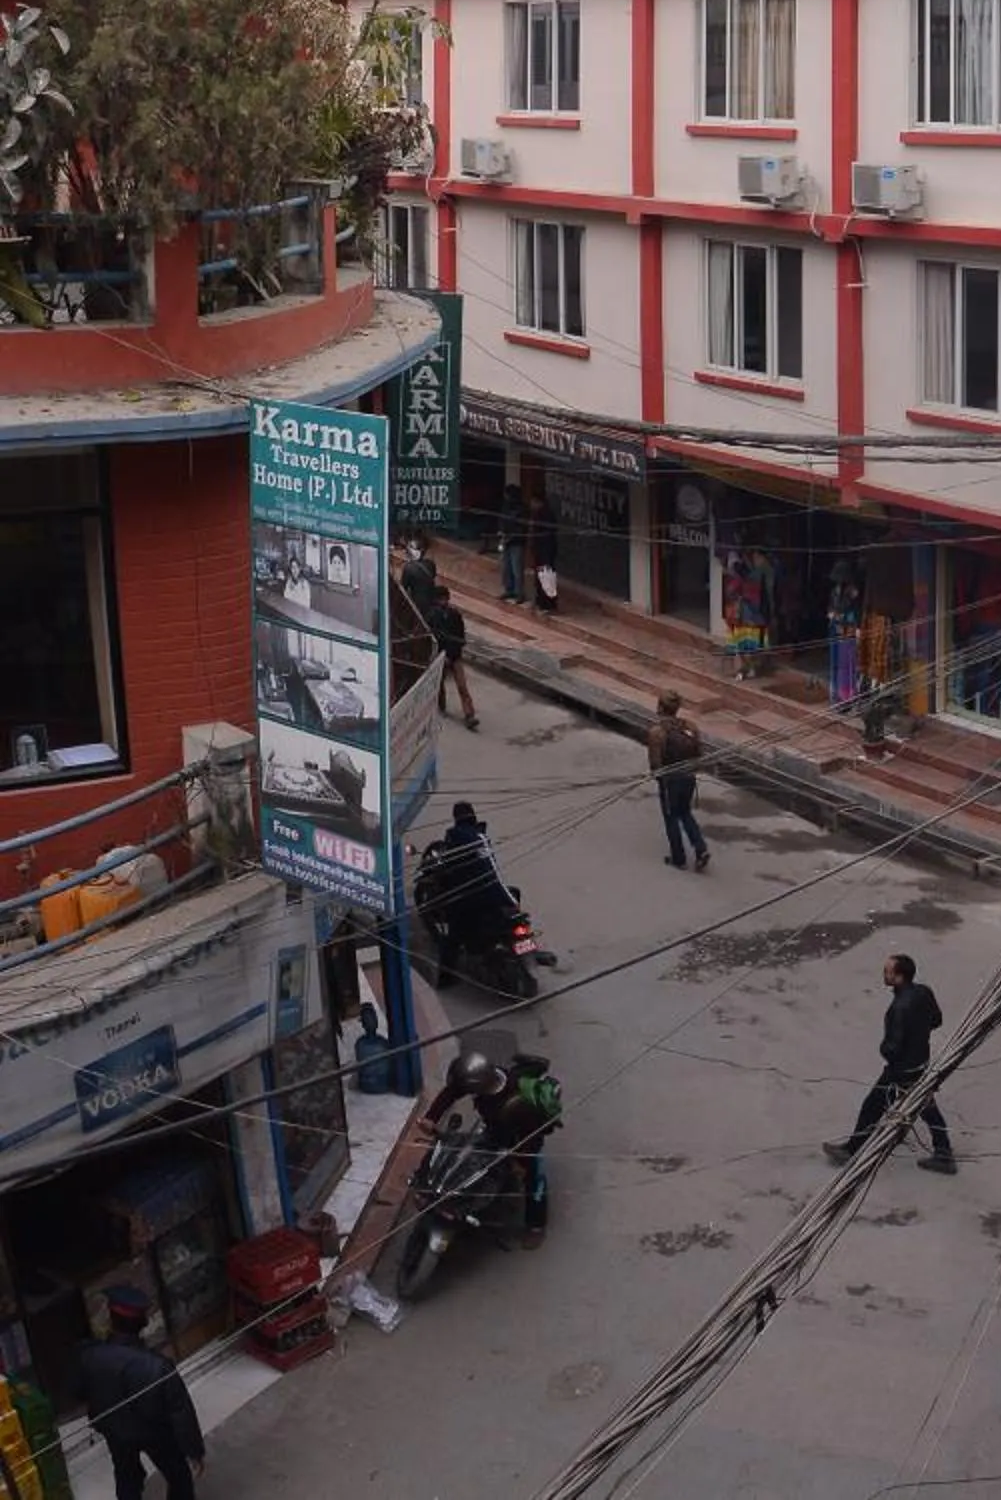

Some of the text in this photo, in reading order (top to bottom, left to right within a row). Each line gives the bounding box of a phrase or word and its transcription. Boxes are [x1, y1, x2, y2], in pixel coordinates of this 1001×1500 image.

[253, 403, 379, 459] Karma
[270, 443, 360, 479] Travellers
[253, 463, 303, 493] Home
[342, 481, 379, 509] Ltd.
[393, 484, 449, 505] HOME
